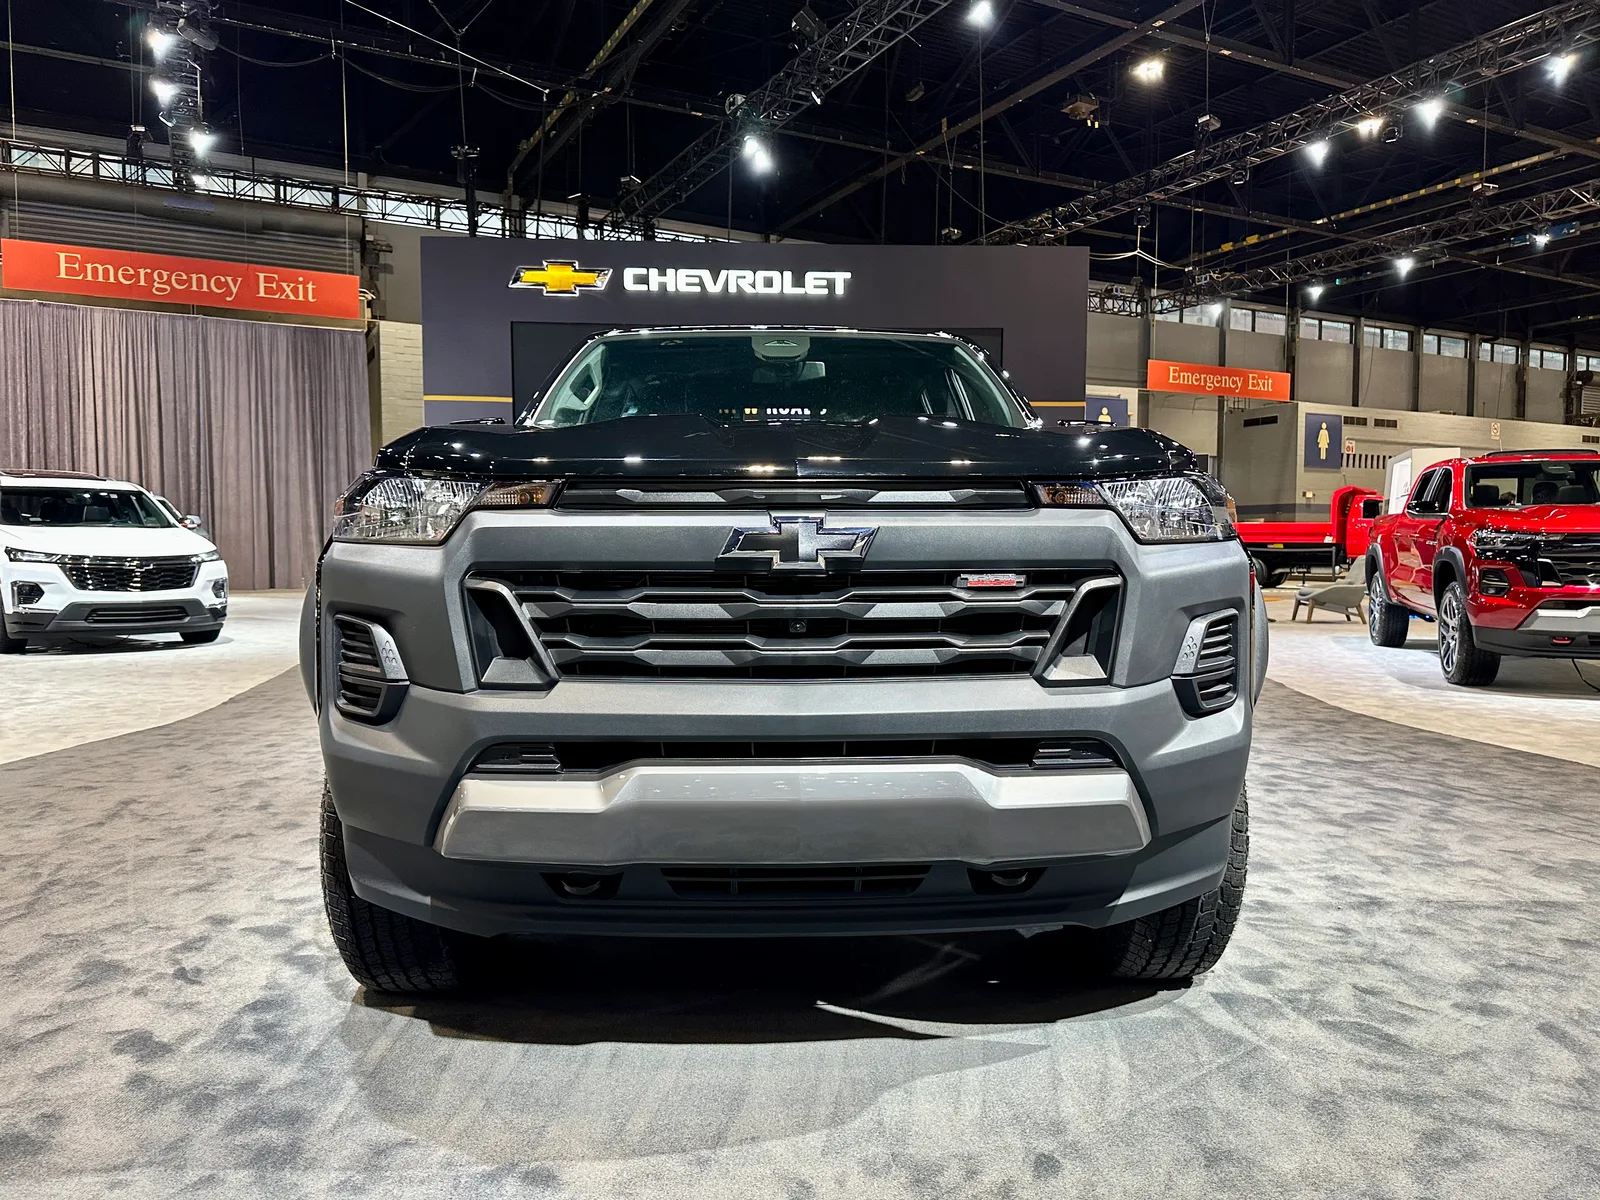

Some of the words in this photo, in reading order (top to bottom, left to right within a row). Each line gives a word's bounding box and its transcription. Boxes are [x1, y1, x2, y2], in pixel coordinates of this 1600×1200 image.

[56, 251, 243, 302] Emergency
[256, 272, 317, 303] Exit
[623, 267, 852, 295] CHEVROLET
[1168, 366, 1243, 393] Emergency
[1247, 373, 1273, 392] Exit
